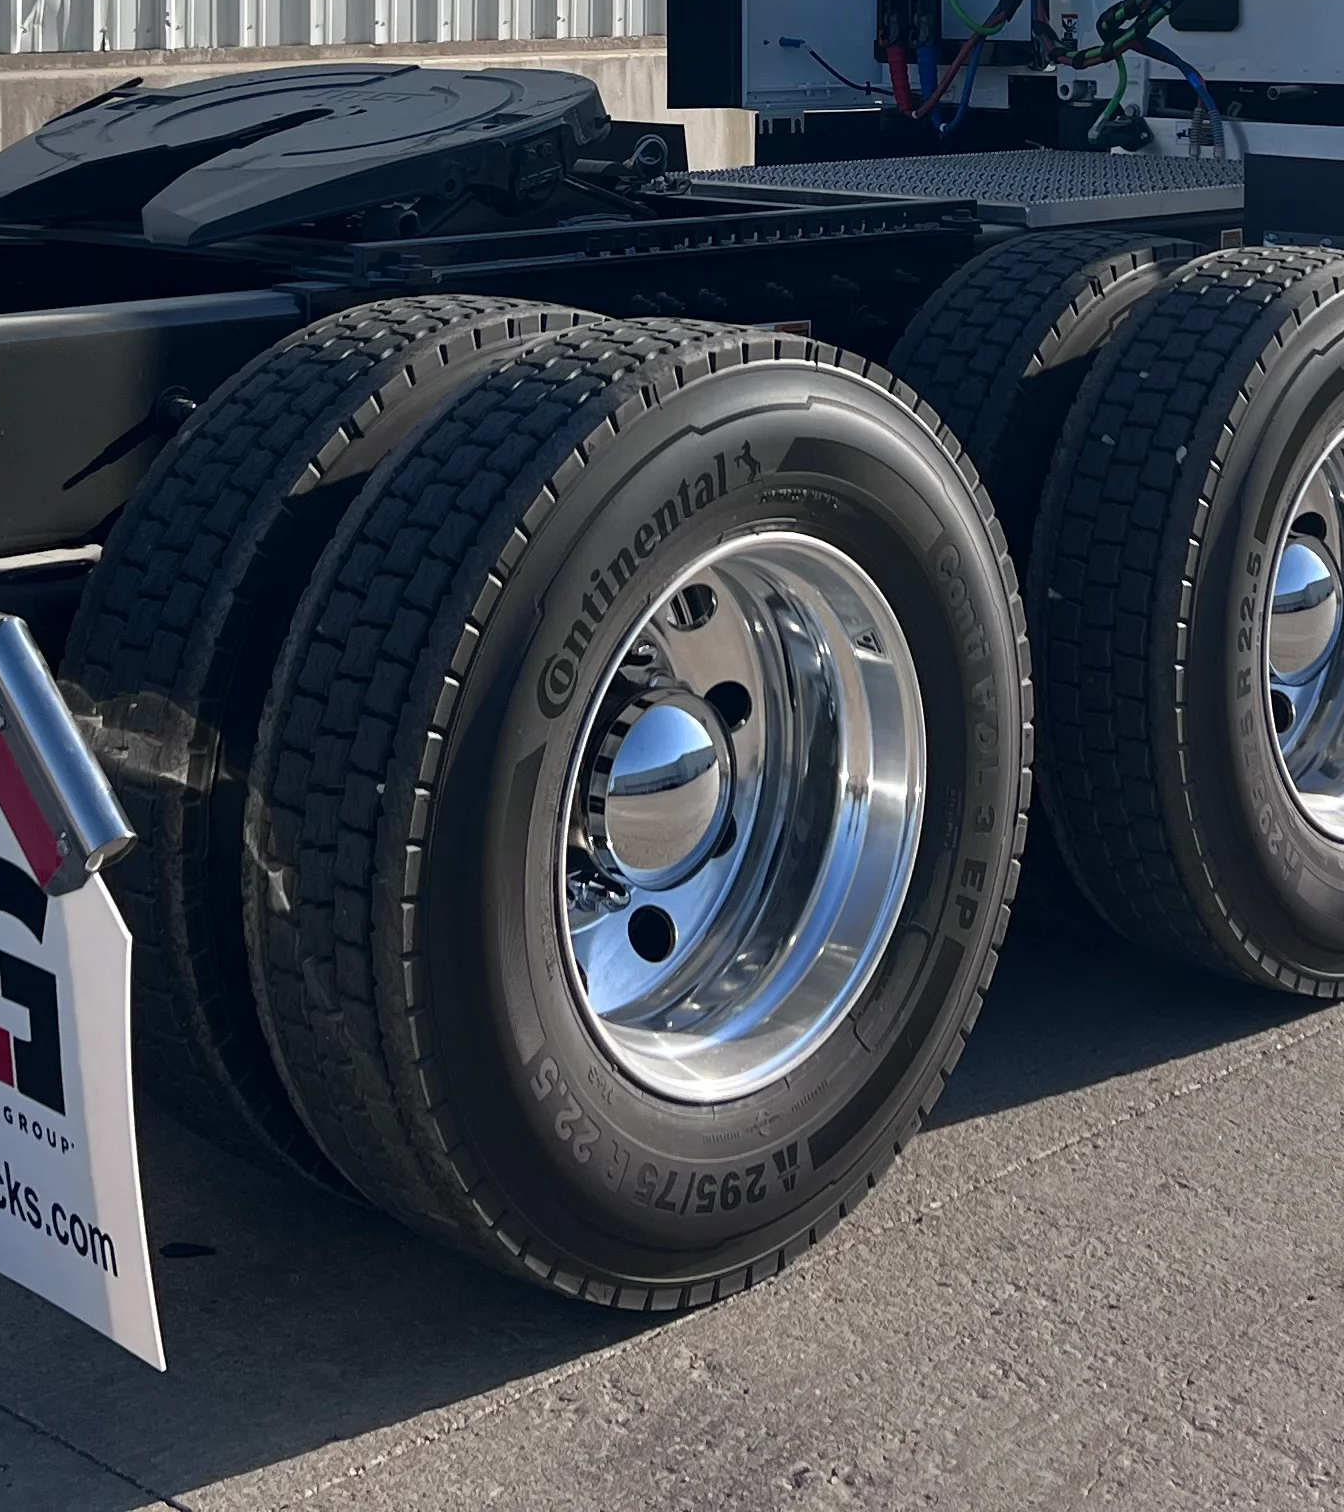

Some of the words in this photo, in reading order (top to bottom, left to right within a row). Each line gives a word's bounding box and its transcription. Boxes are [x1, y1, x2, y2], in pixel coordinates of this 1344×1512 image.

[536, 451, 729, 719] Continental
[974, 807, 995, 835] 3
[955, 855, 990, 932] EP
